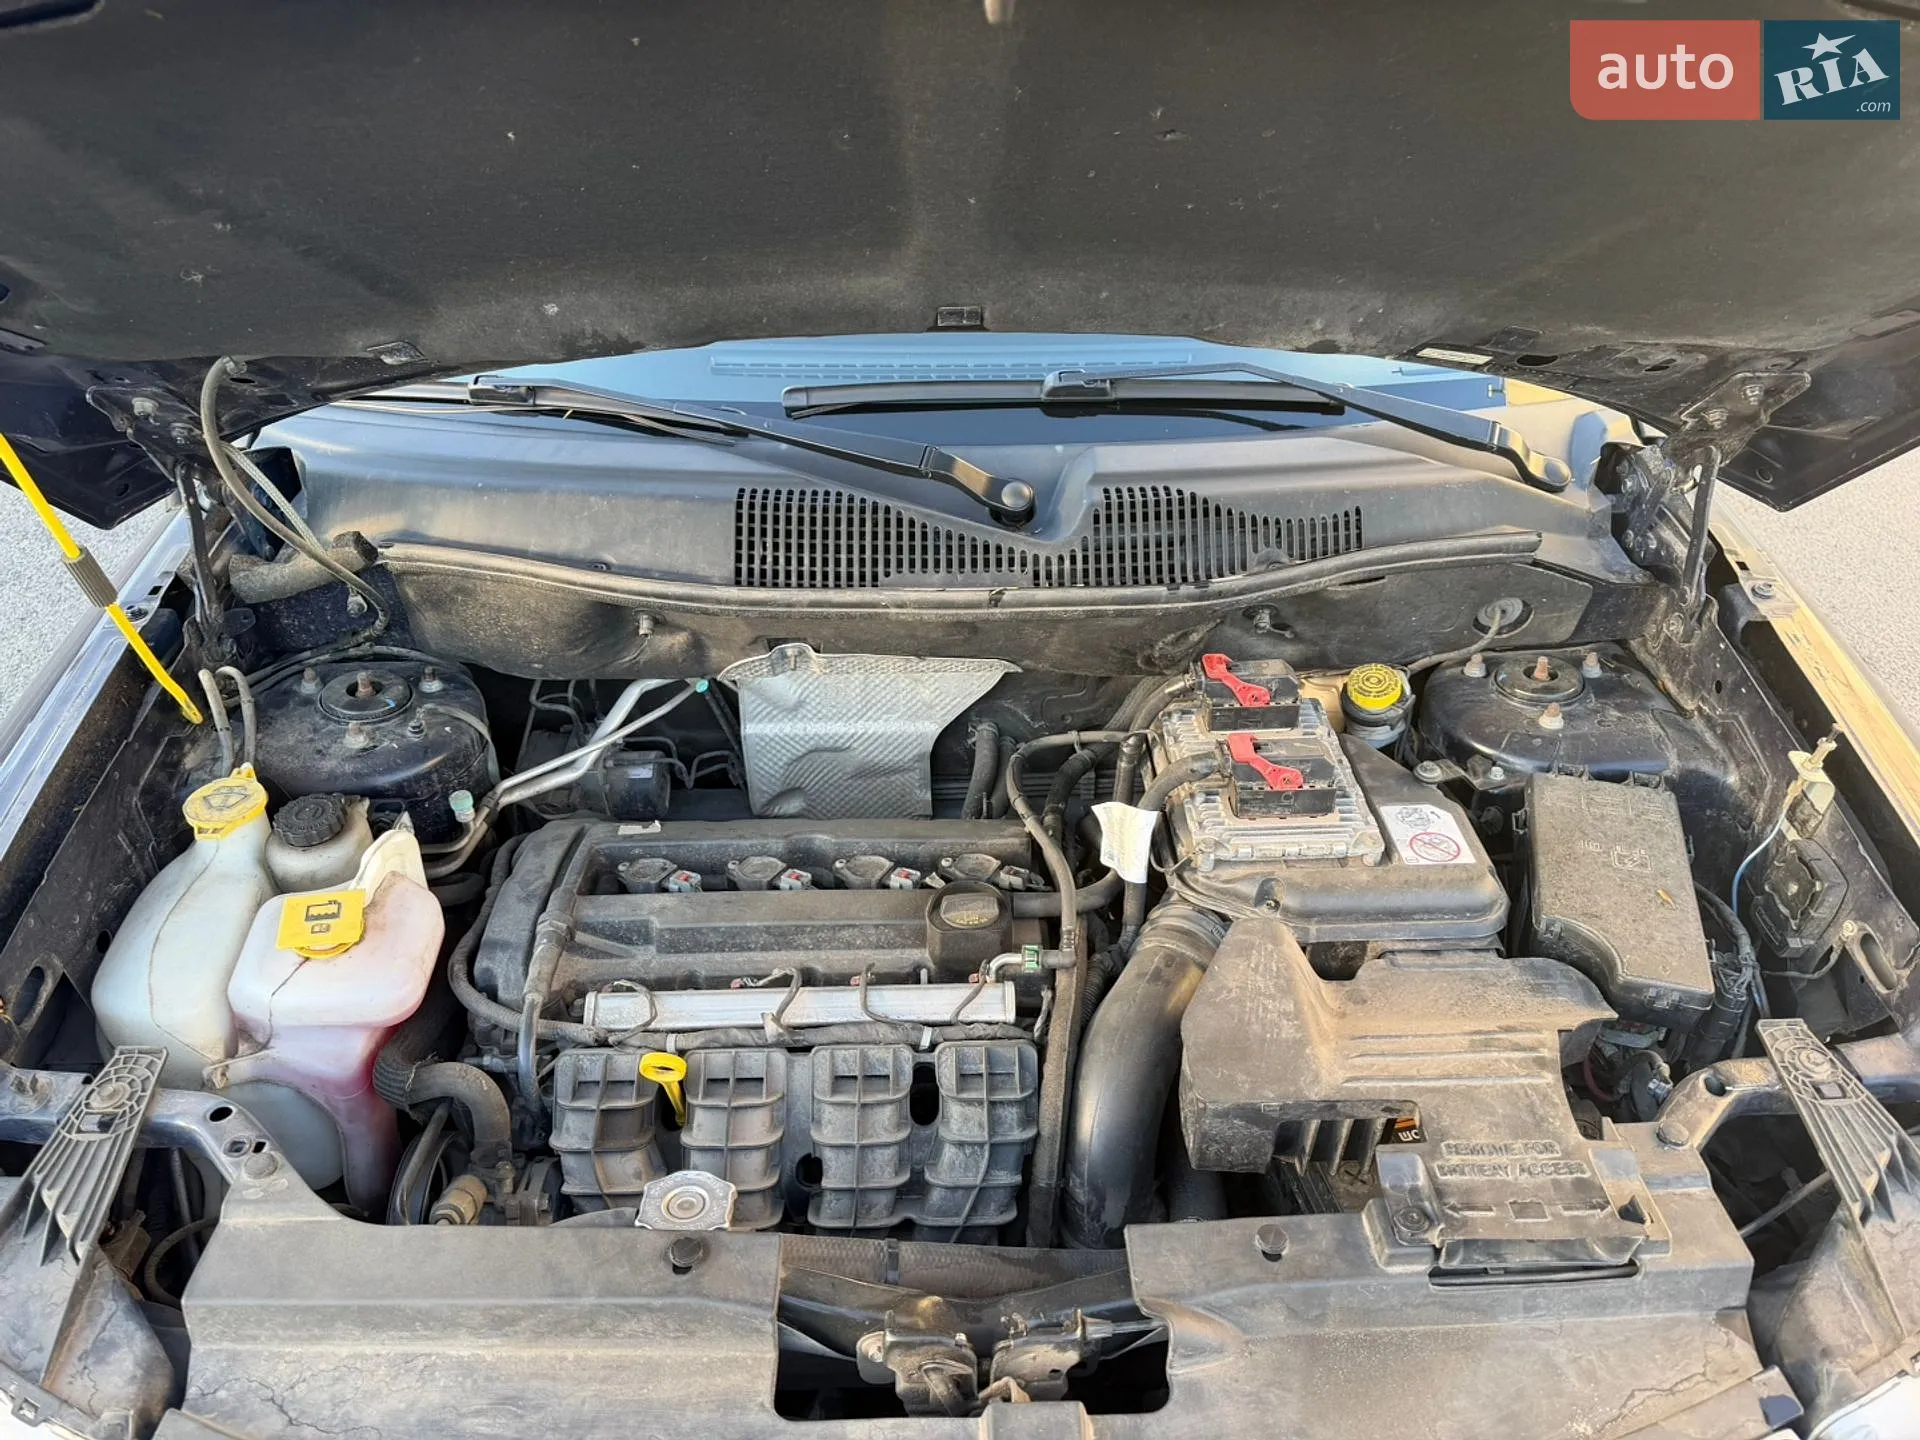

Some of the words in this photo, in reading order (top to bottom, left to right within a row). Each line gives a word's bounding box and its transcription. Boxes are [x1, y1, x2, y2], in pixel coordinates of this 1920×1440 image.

[1523, 1141, 1560, 1155] FOR
[1436, 1162, 1510, 1177] BATTERY
[1518, 1161, 1589, 1177] ACCESS
